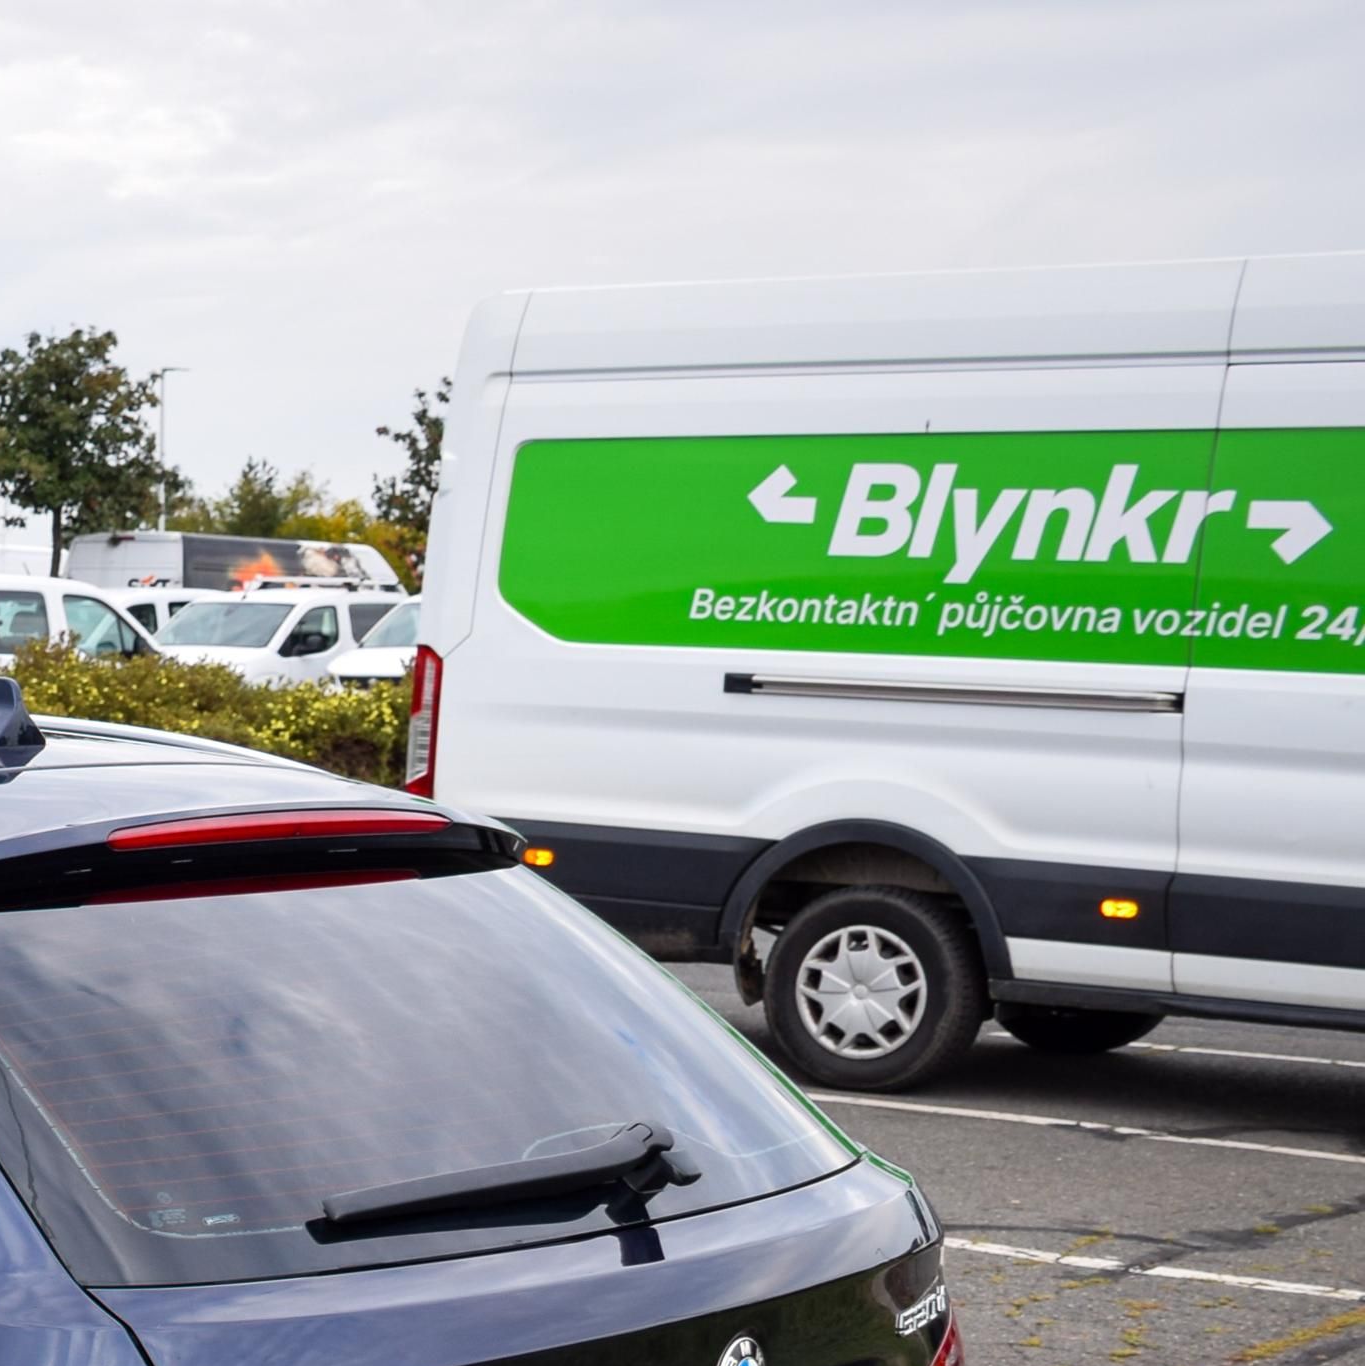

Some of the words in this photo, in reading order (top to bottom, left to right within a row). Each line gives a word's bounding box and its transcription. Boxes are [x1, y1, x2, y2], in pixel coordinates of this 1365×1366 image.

[827, 463, 1237, 584] Blynkr
[937, 591, 1121, 637] půjčovna
[1133, 602, 1288, 639] vozidel
